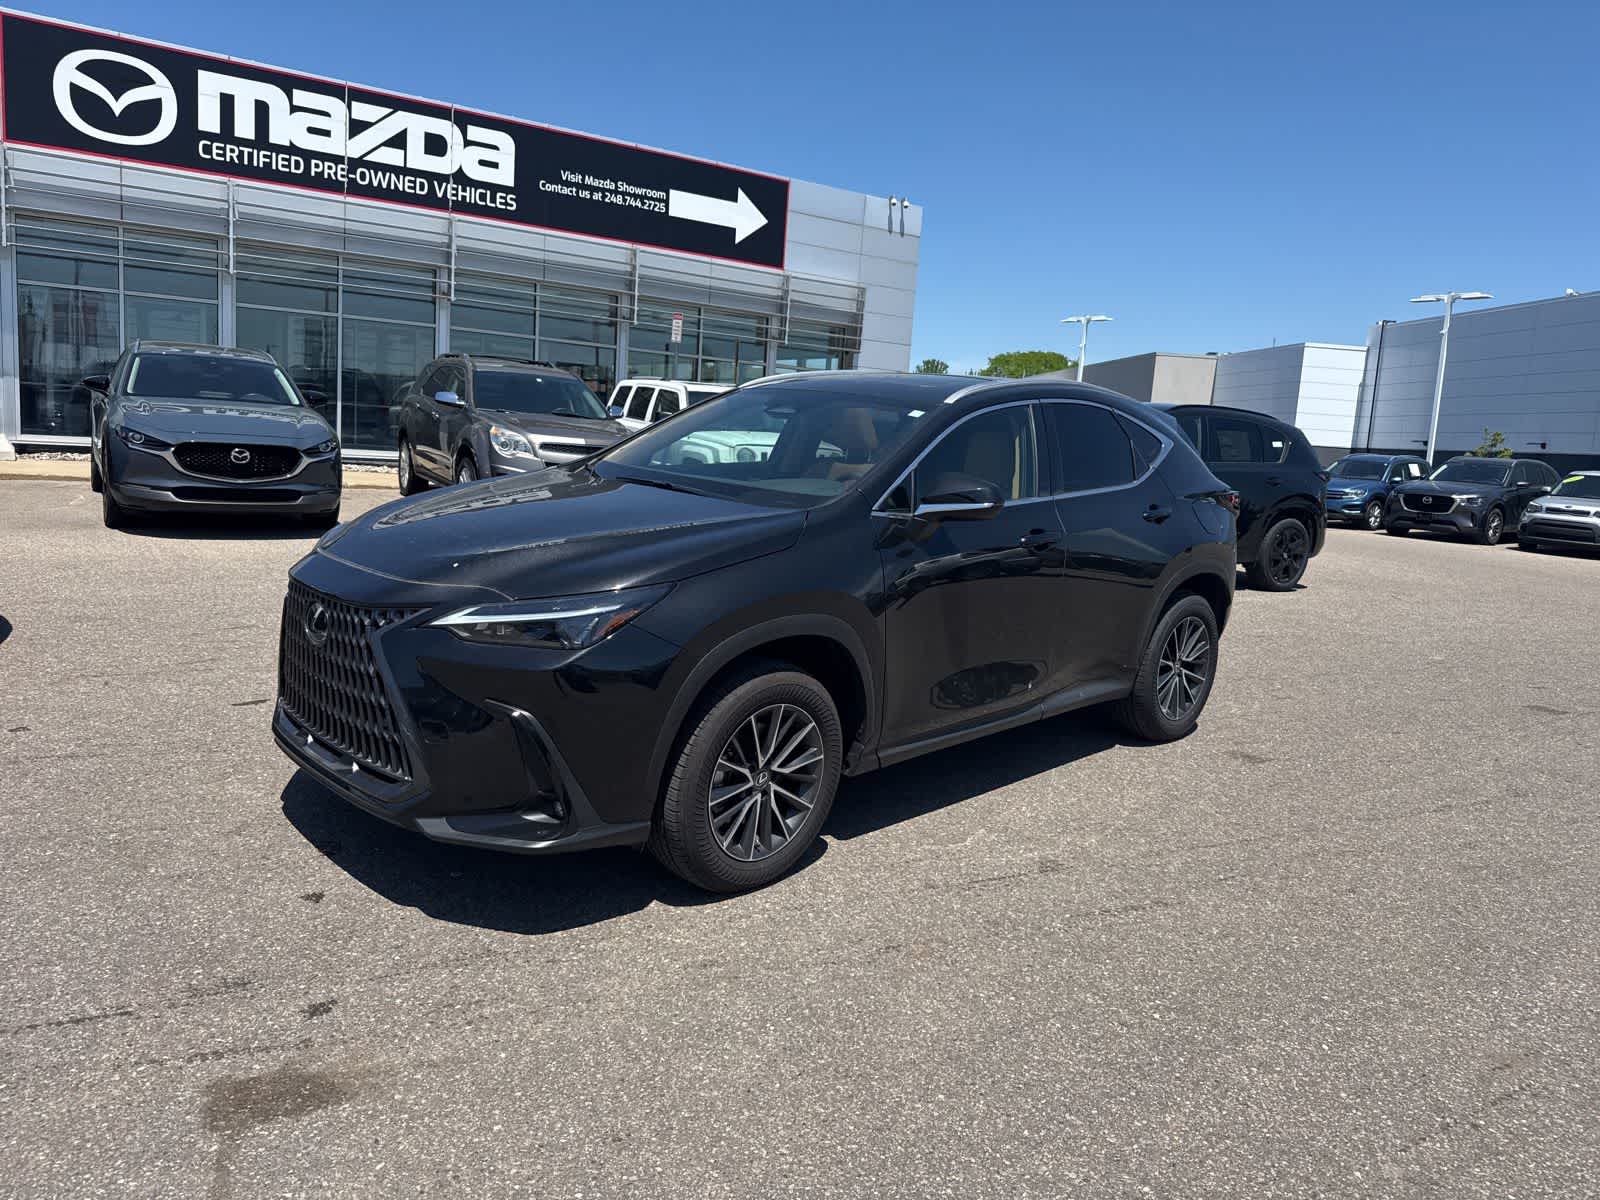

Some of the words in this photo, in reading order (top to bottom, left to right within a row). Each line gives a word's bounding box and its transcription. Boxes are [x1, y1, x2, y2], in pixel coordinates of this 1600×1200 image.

[198, 140, 304, 173] CERTIFIED
[310, 162, 429, 195] PRE-OWNED
[433, 180, 517, 211] VEHICLES
[561, 170, 582, 183] Visit
[584, 175, 615, 190] Mazda
[617, 181, 667, 199] Showroom
[539, 180, 577, 196] Contact
[579, 189, 591, 199] us
[592, 191, 603, 201] at
[604, 192, 666, 212] 248.744.2725
